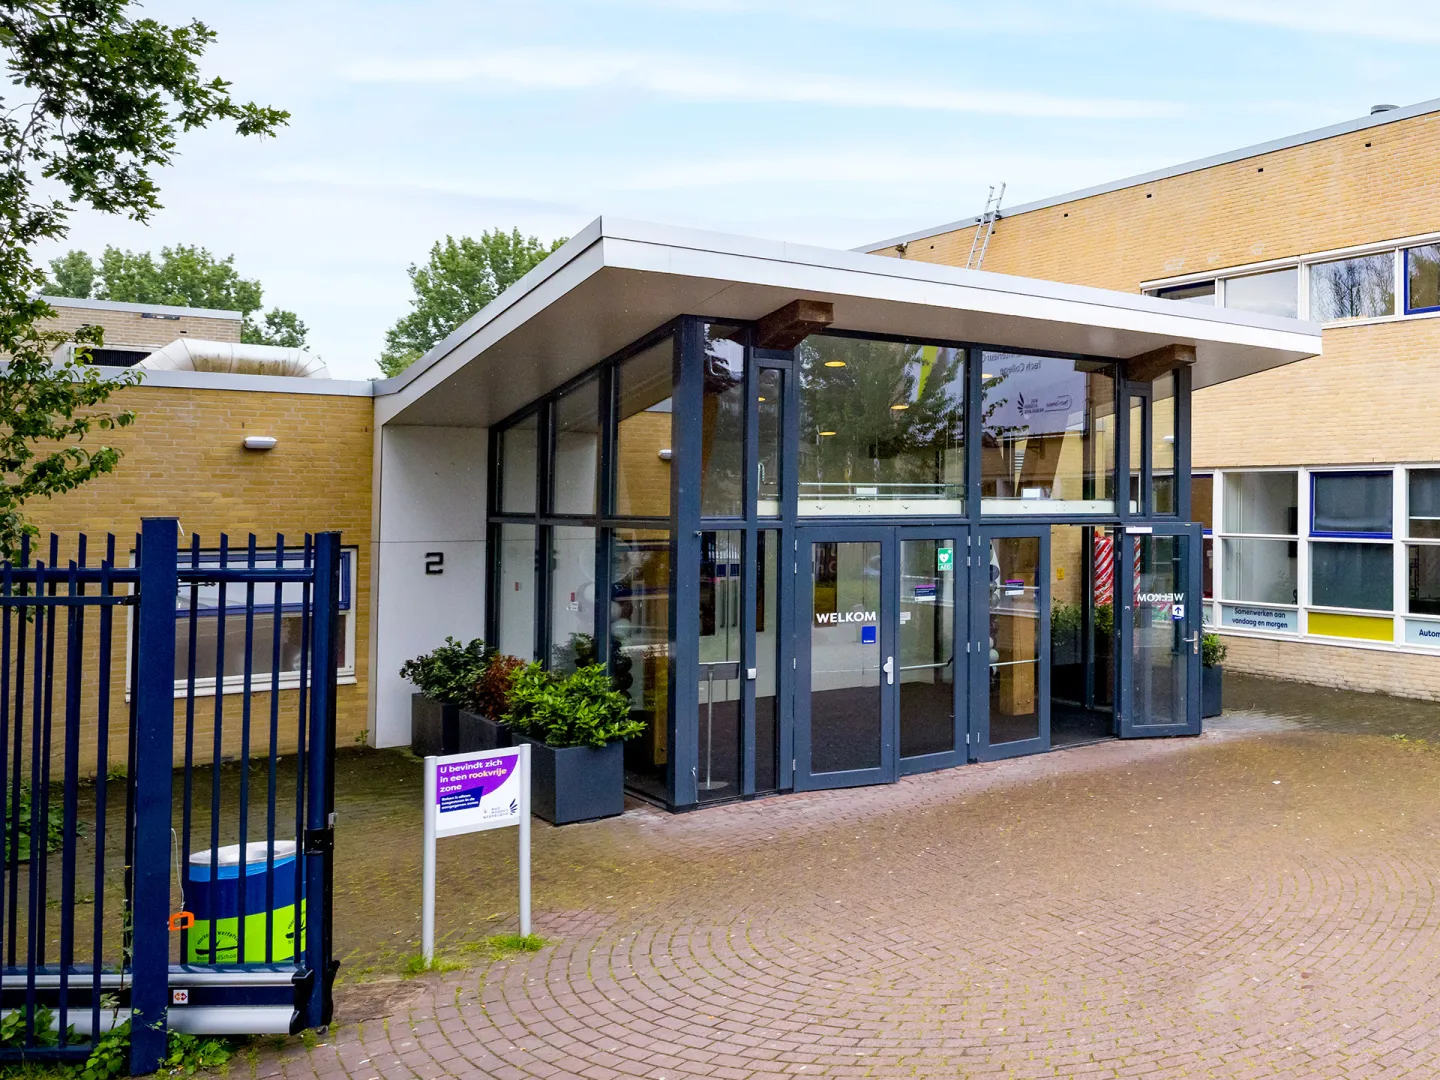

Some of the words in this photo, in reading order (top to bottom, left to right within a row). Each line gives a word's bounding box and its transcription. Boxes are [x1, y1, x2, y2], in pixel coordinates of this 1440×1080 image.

[425, 552, 444, 575] 2
[816, 611, 877, 624] WELKOM
[1234, 607, 1273, 618] Samenwerken
[1232, 617, 1257, 627] vandaag
[1266, 620, 1288, 629] morgen
[449, 762, 483, 772] bevindt
[484, 759, 502, 767] zich
[450, 773, 467, 782] een
[468, 768, 507, 779] rookvrije
[440, 784, 462, 793] zone
